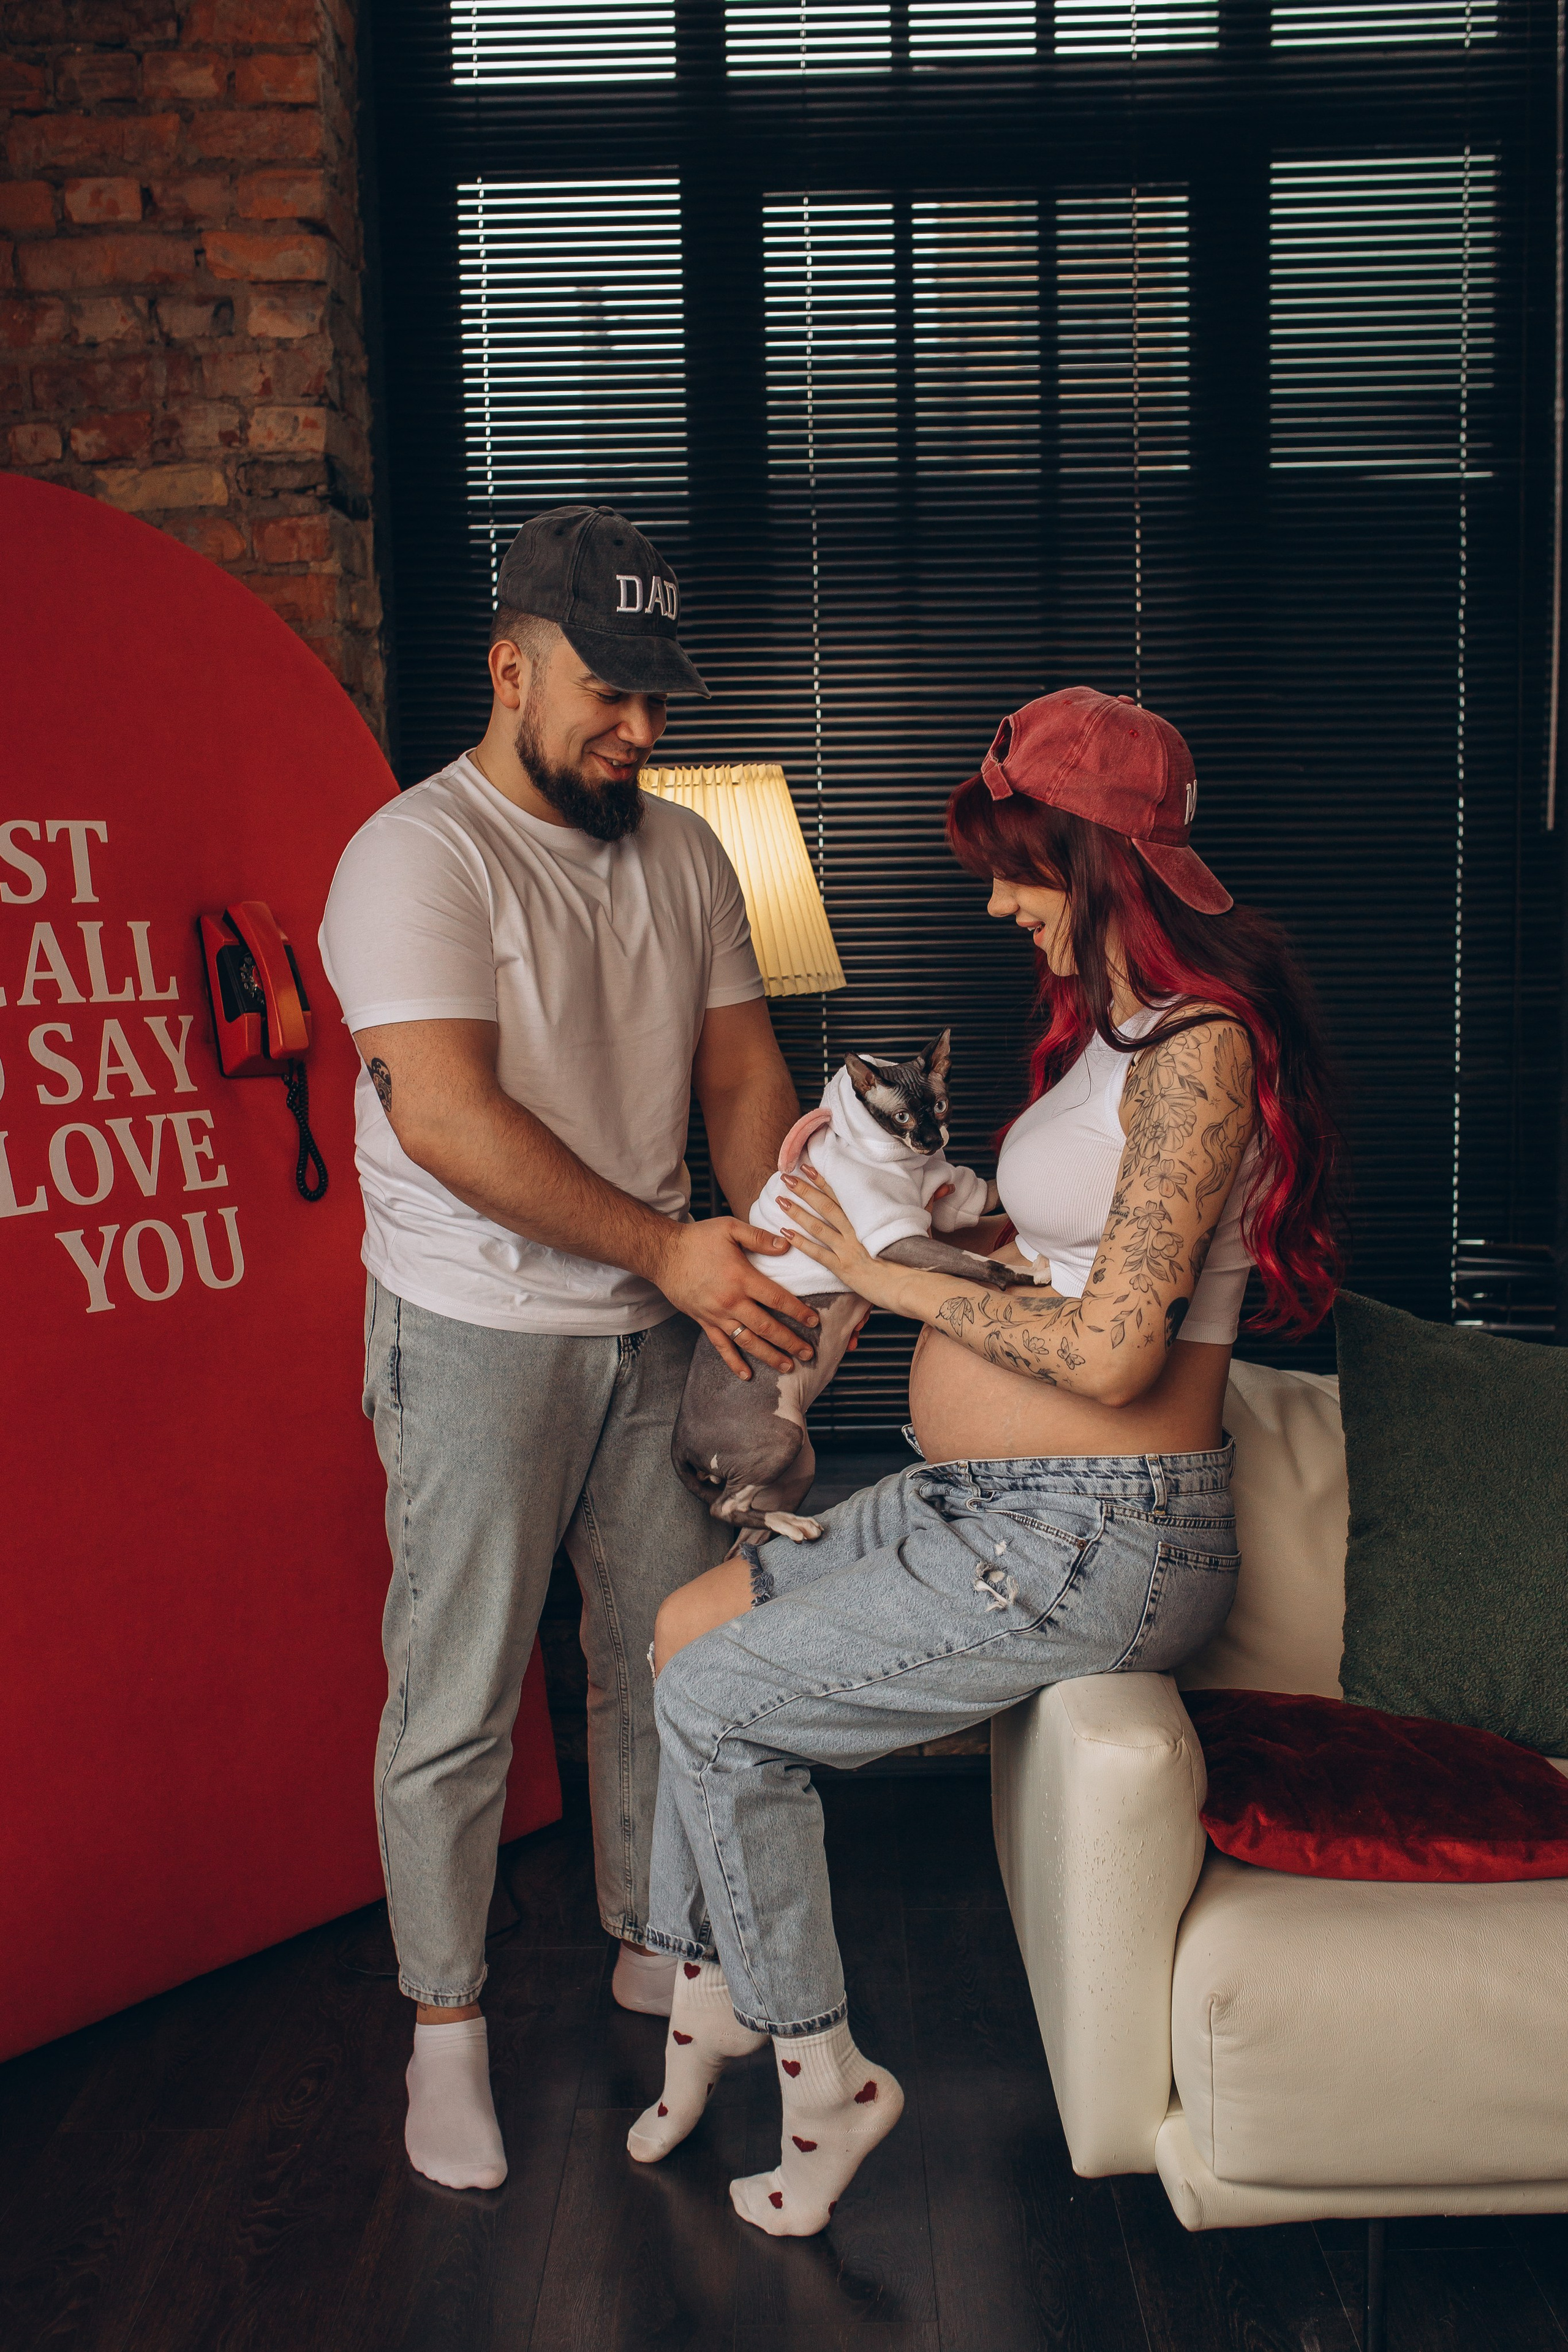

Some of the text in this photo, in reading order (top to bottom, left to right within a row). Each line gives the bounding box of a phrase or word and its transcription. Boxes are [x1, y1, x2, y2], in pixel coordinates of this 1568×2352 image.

[616, 575, 678, 620] DAD
[0, 921, 179, 1008] ALL
[28, 1015, 198, 1105] SAY
[0, 1109, 228, 1218] LOVE
[54, 1206, 244, 1313] YOU
